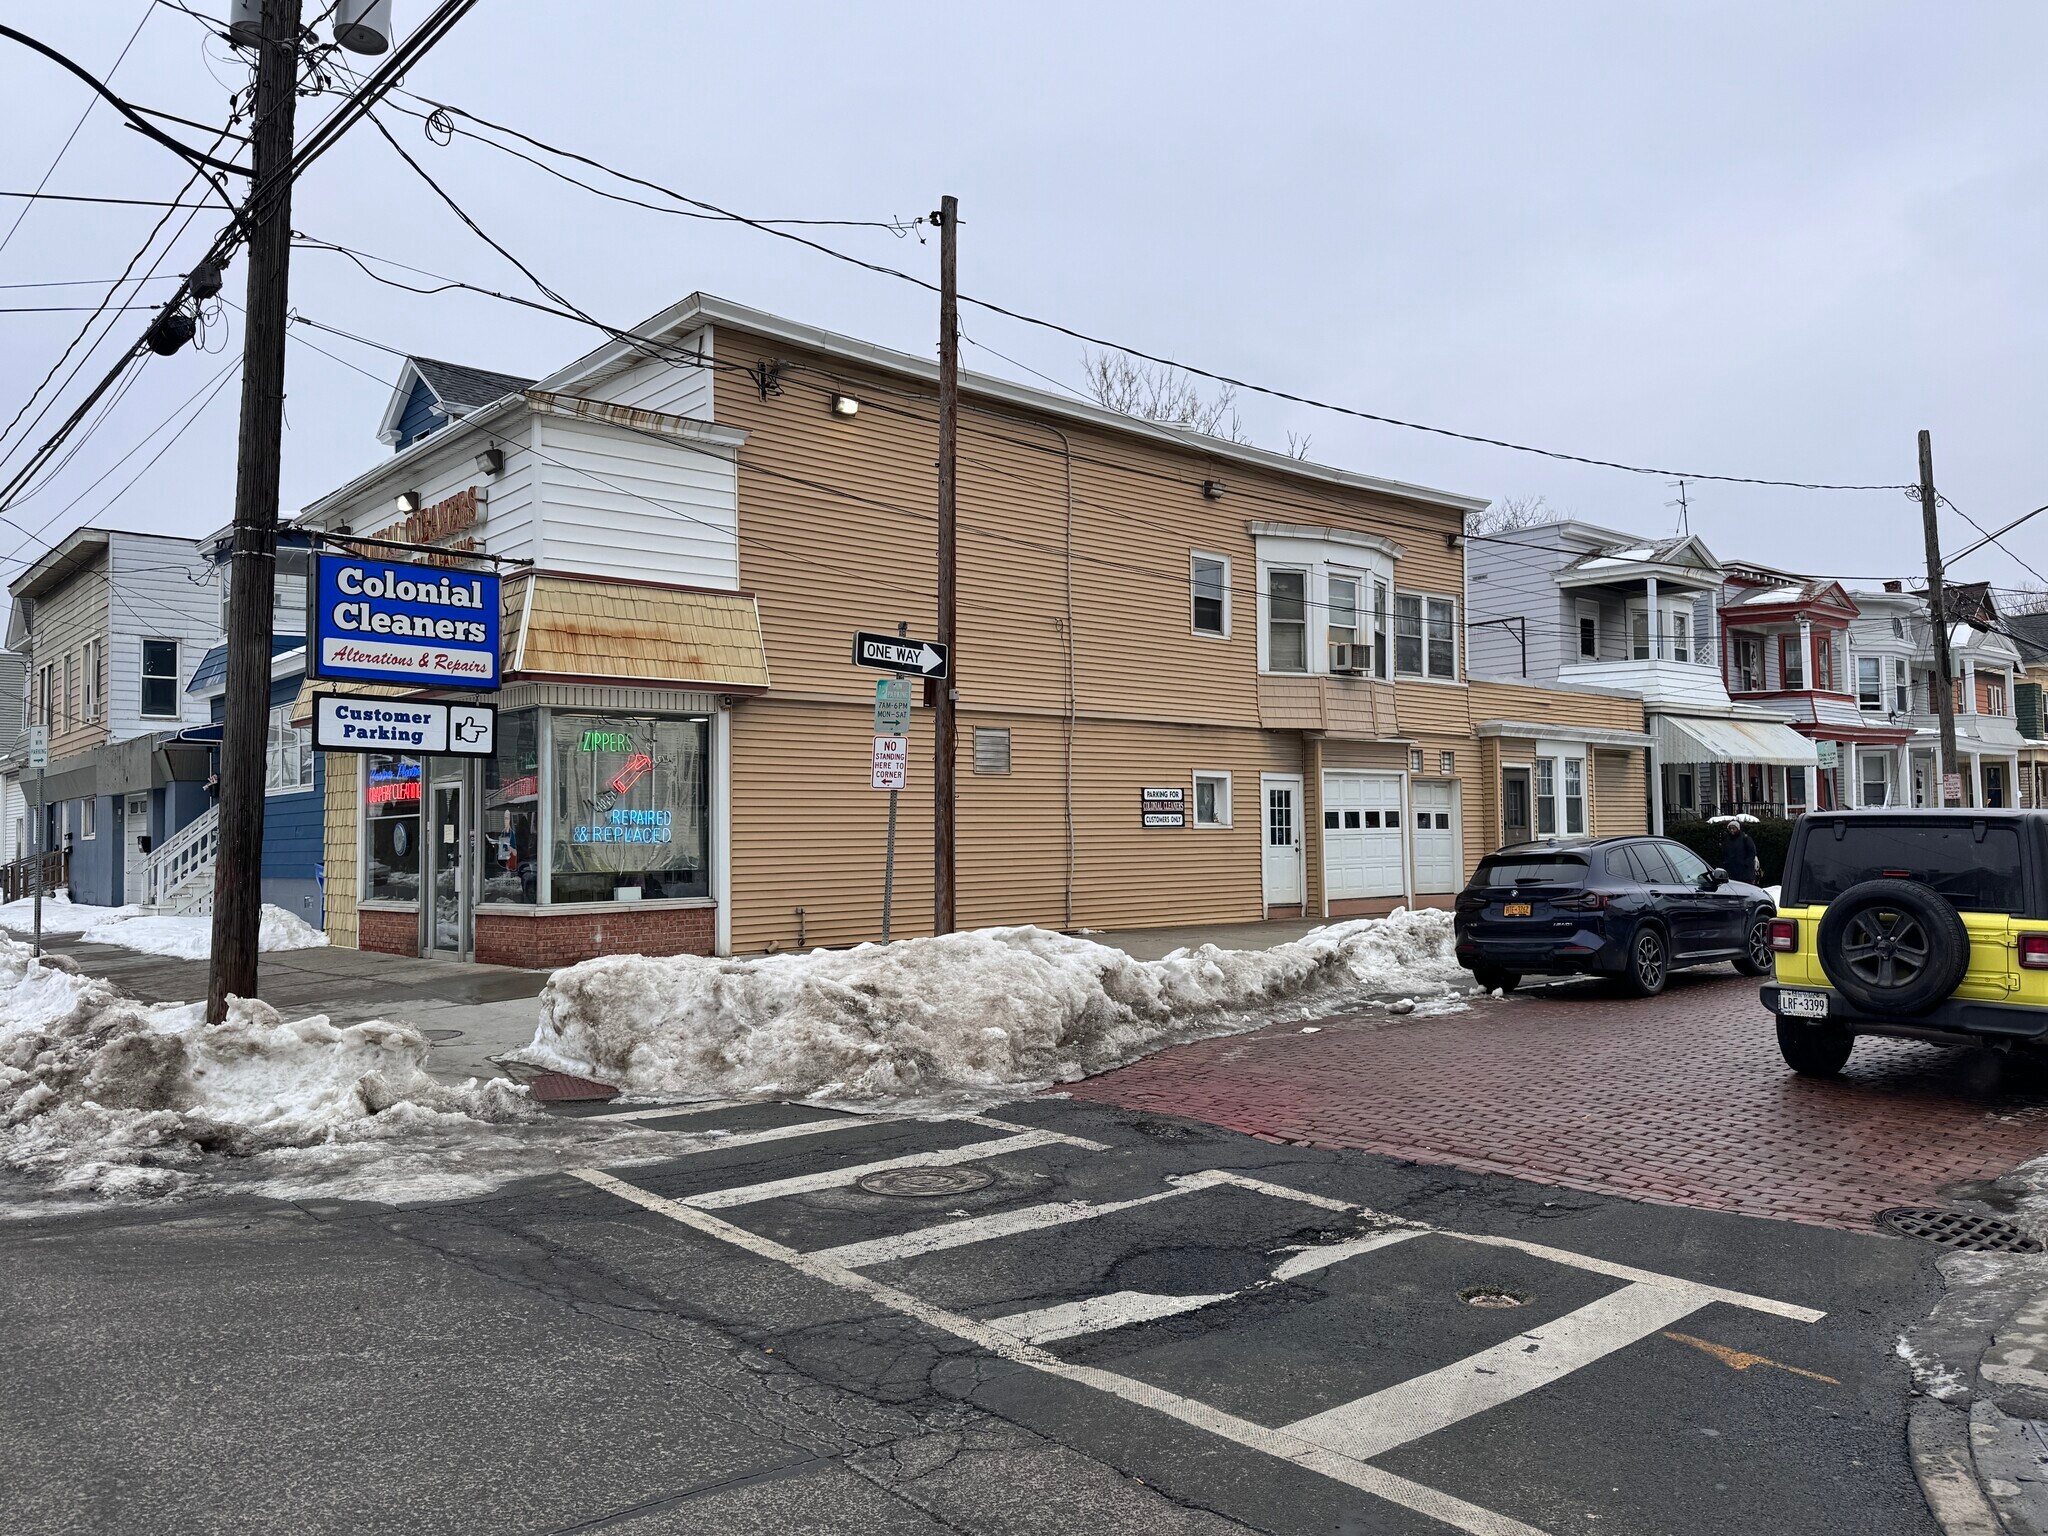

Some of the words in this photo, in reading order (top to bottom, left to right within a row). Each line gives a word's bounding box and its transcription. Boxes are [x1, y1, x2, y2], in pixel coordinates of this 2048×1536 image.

[337, 567, 483, 609] Colonial
[333, 602, 486, 642] Cleaners
[331, 645, 413, 667] Alterations
[418, 652, 429, 667] &
[434, 654, 487, 674] Repairs
[867, 643, 892, 659] ONE
[896, 647, 921, 664] WAY
[335, 705, 431, 724] Customer
[343, 724, 424, 745] Parking
[582, 731, 633, 752] ZIPPERS
[884, 741, 897, 752] NO
[874, 762, 892, 770] HERE
[896, 762, 904, 770] TO
[612, 809, 672, 826] REPAIRED
[592, 827, 672, 844] REPLACED
